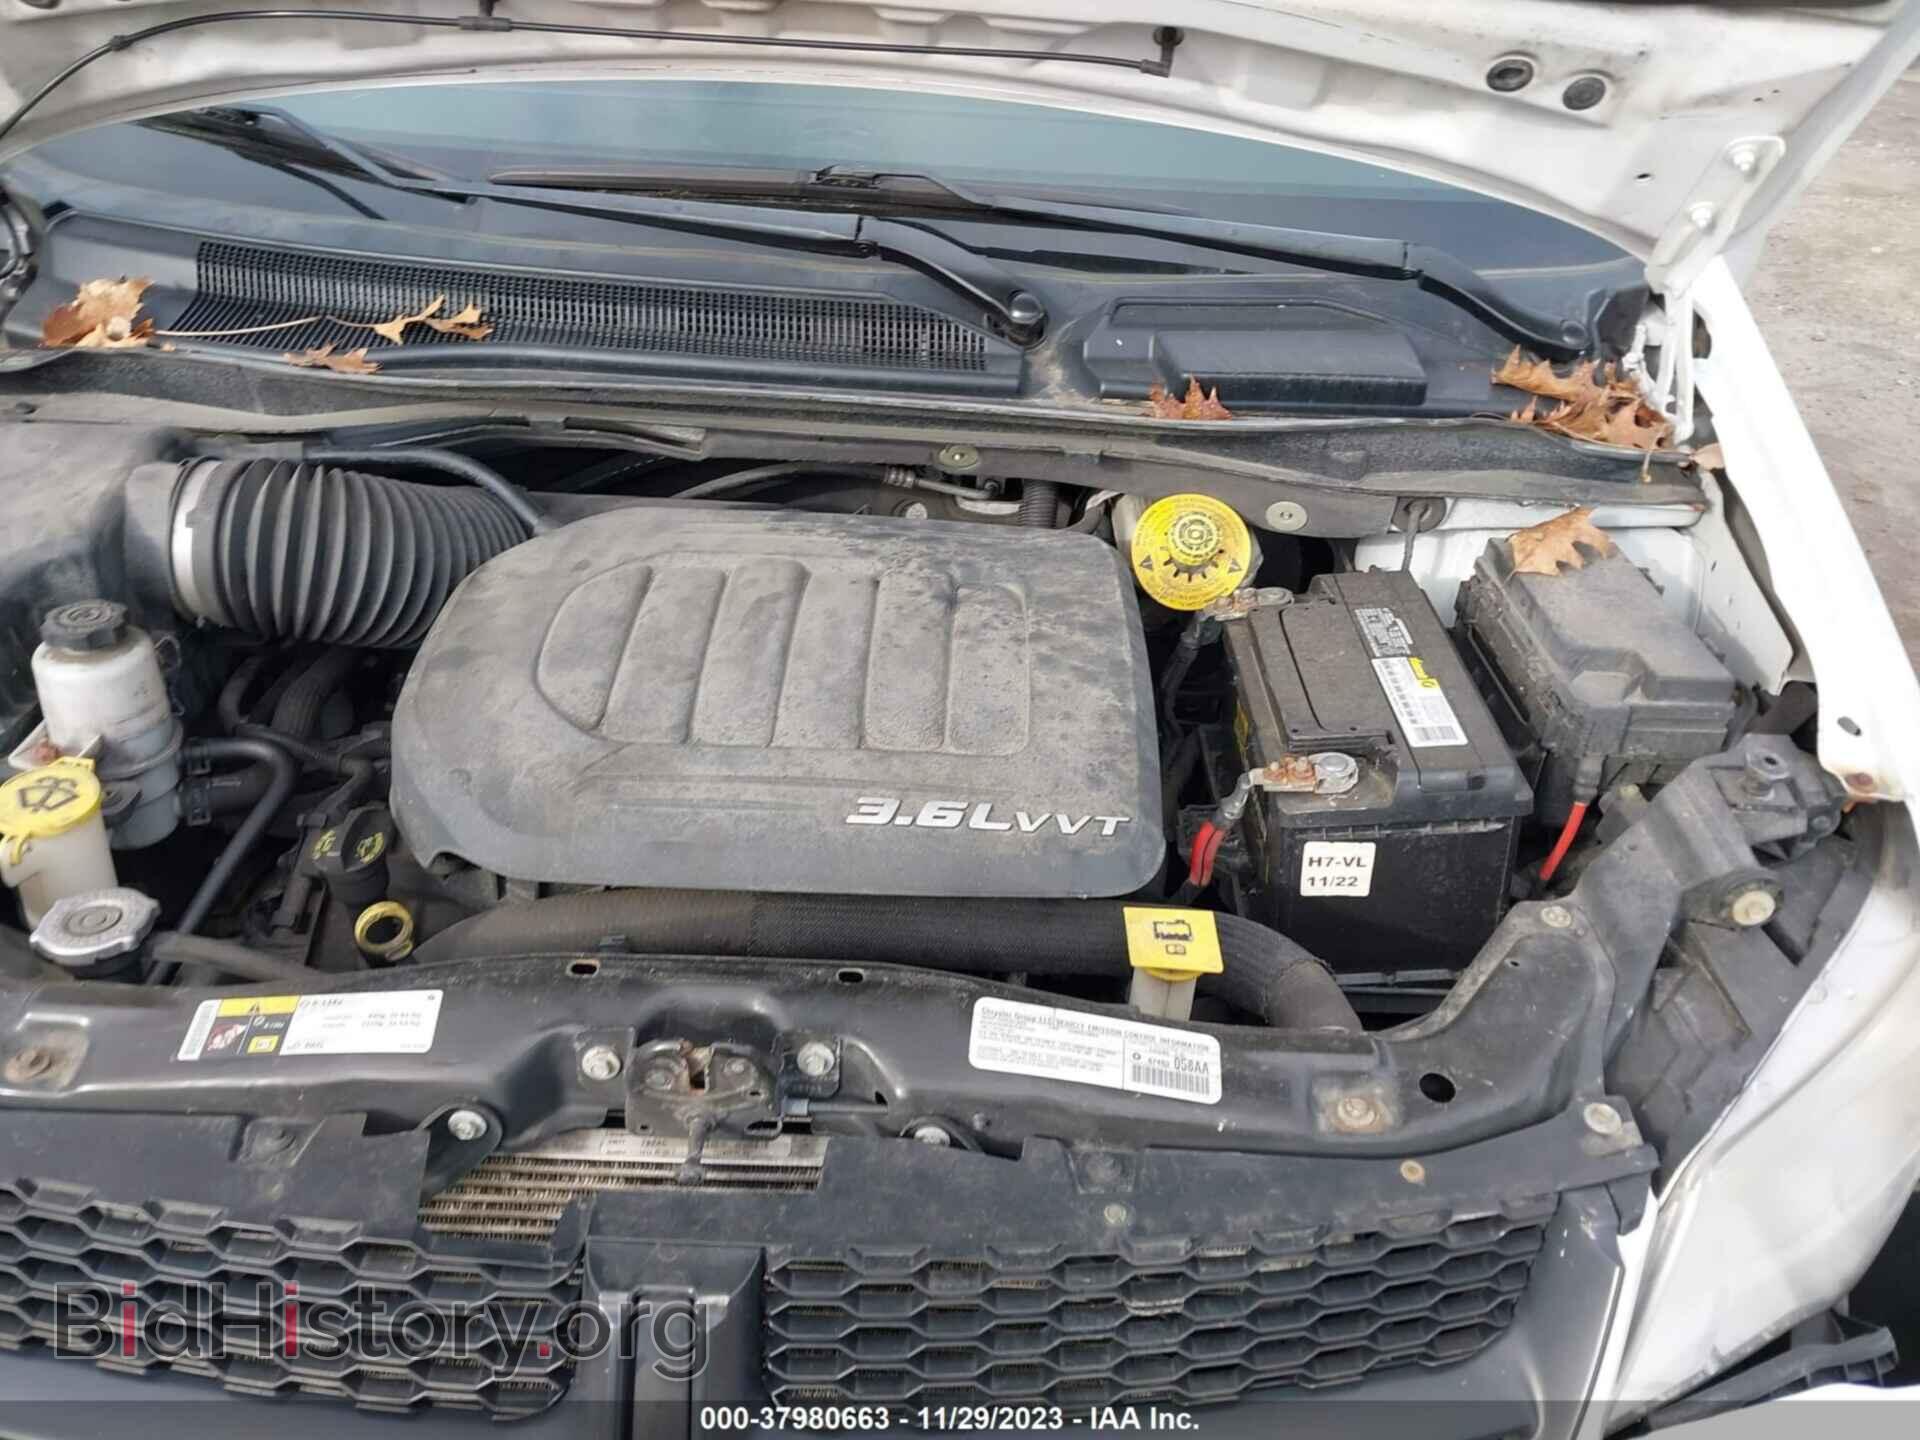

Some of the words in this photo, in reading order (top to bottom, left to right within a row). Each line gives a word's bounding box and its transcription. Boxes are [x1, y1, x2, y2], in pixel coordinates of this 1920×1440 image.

[845, 796, 1012, 831] 3.6L
[1308, 856, 1367, 868] H7-VL
[1306, 876, 1359, 887] 11/22
[1173, 1056, 1210, 1075] 058AA
